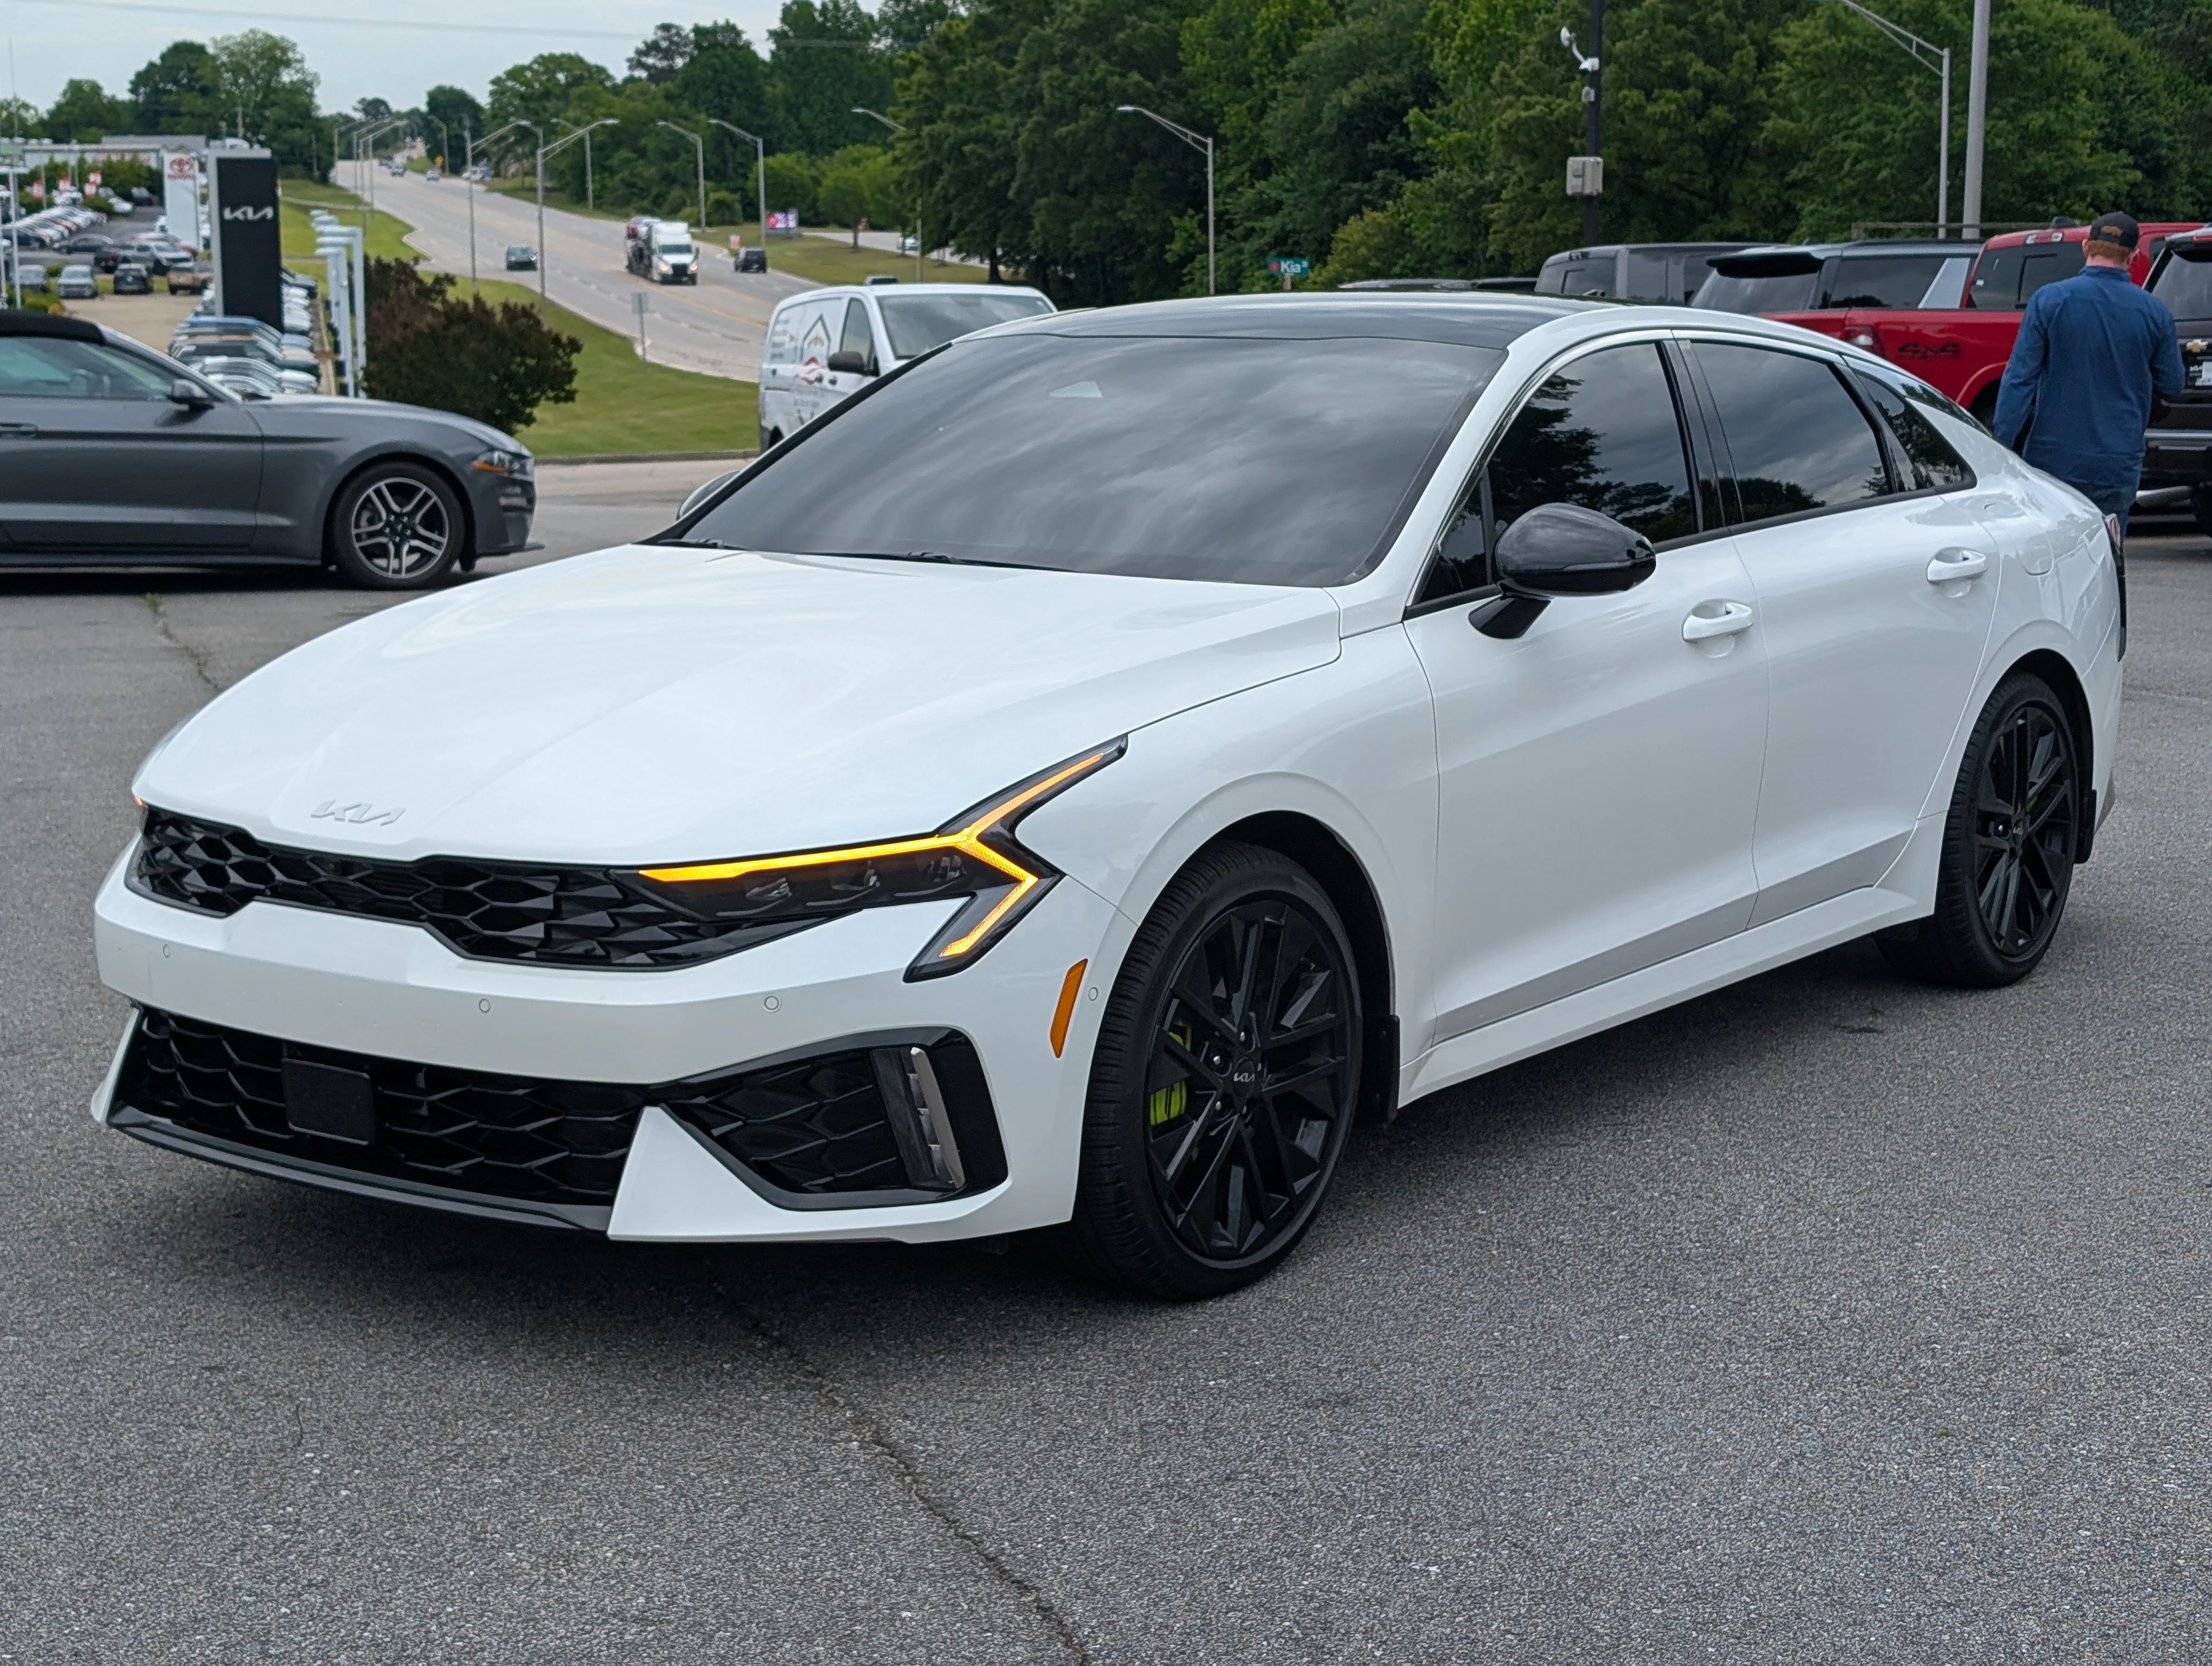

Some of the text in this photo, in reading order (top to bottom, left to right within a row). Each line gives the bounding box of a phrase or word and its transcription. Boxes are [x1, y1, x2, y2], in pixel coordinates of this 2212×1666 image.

[223, 206, 274, 221] KIA
[1281, 260, 1301, 273] Kia
[310, 798, 406, 826] KIA
[1233, 1072, 1255, 1082] KIA
